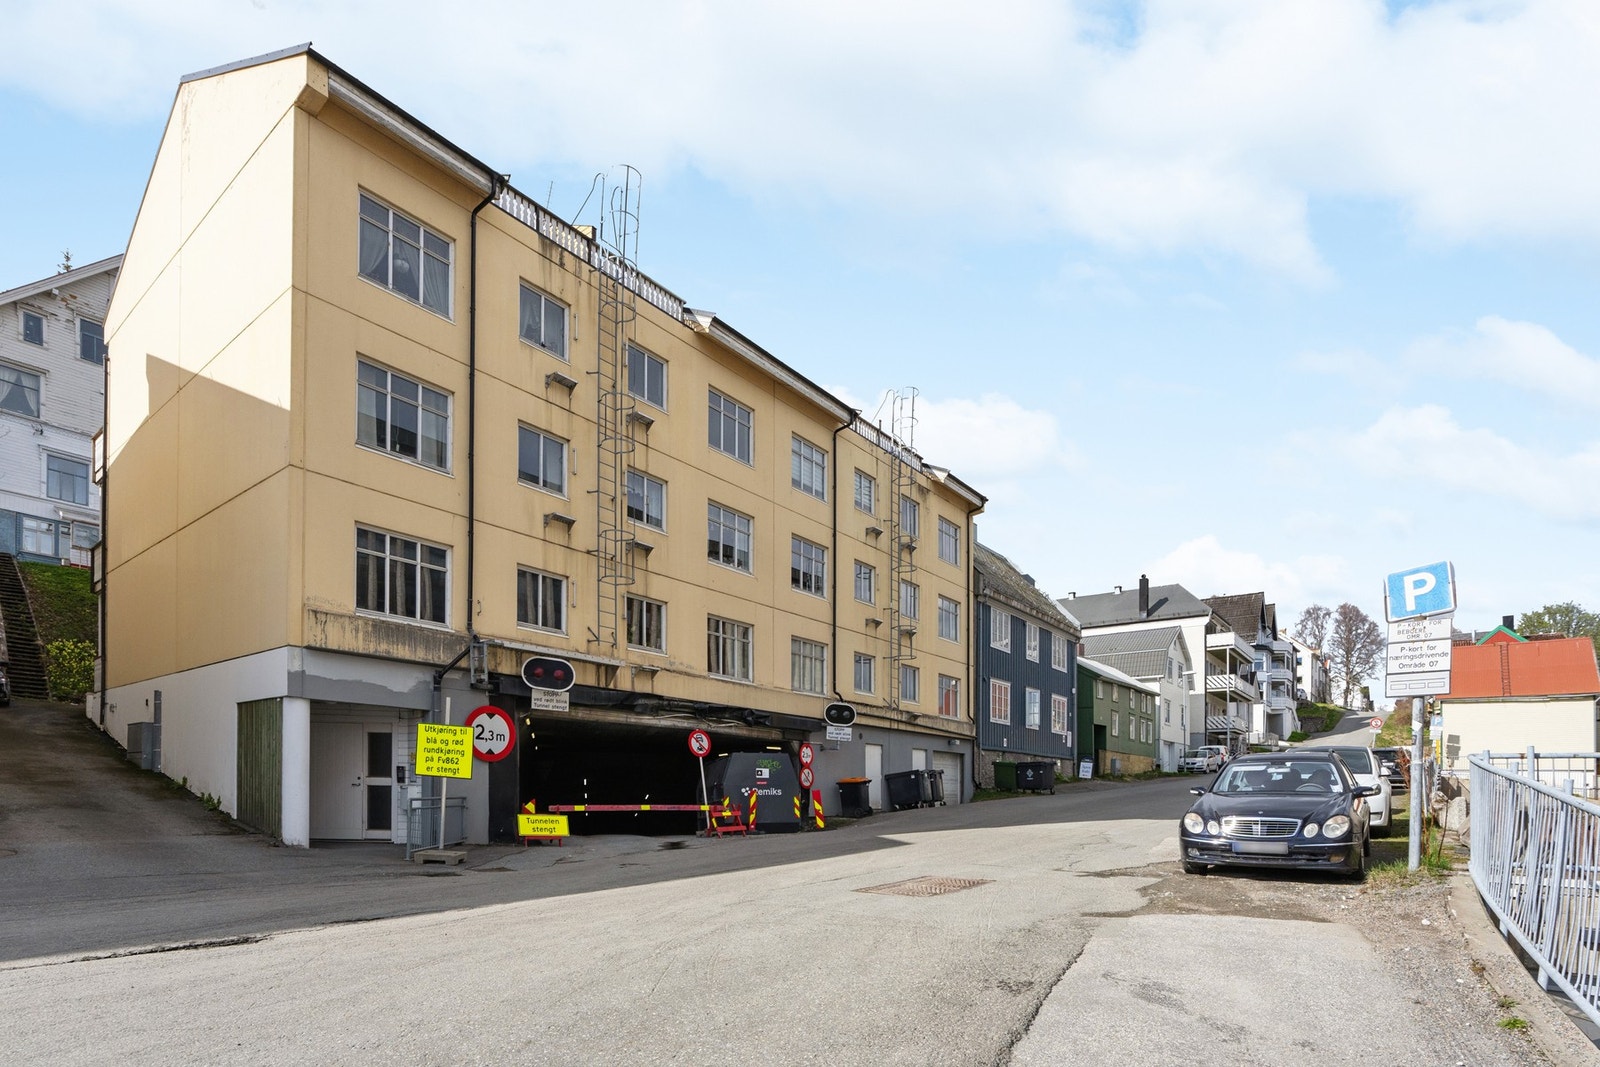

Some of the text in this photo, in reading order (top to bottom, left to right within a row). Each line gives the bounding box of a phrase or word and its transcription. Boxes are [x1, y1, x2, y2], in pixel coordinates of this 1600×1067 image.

[1403, 571, 1437, 612] P
[1400, 645, 1423, 653] P-kort
[1388, 651, 1449, 662] næringsdrivende
[1398, 660, 1439, 670] Område 07
[424, 725, 457, 736] Utkjøring
[423, 746, 465, 757] rundkjøring
[425, 755, 460, 765] på Fv862
[436, 766, 460, 775] stengt
[526, 817, 560, 825] Tunnelen
[532, 826, 557, 834] stengt
